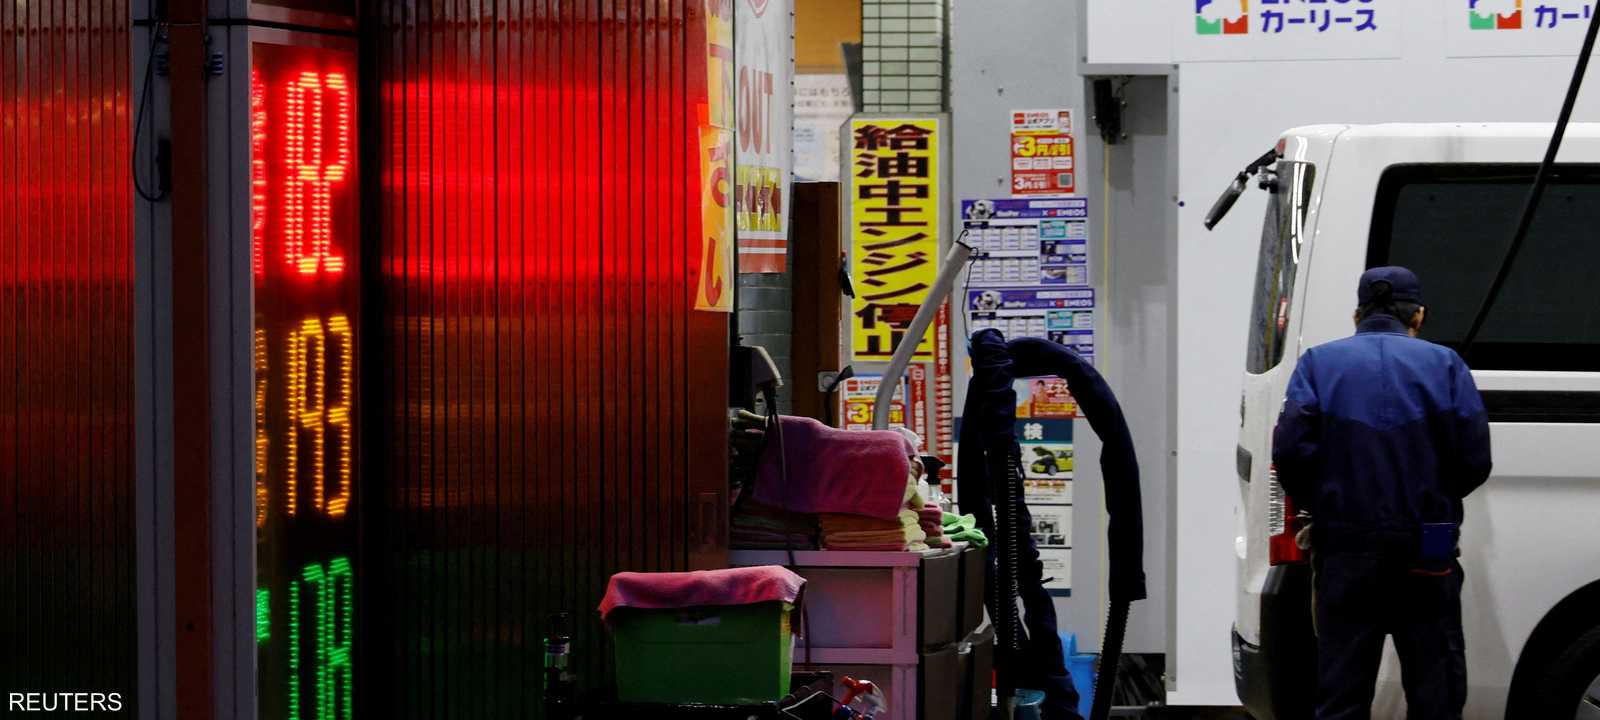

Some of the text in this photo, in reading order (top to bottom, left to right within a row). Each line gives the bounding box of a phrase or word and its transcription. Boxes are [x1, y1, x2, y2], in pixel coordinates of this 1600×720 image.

[1260, 10, 1377, 33] カーリース
[738, 65, 774, 154] OUT
[286, 71, 349, 272] 182
[1057, 209, 1086, 217] ENEOS
[854, 124, 933, 357] 給油中エンジン停止
[288, 315, 353, 516] 193
[1023, 422, 1043, 439] 検
